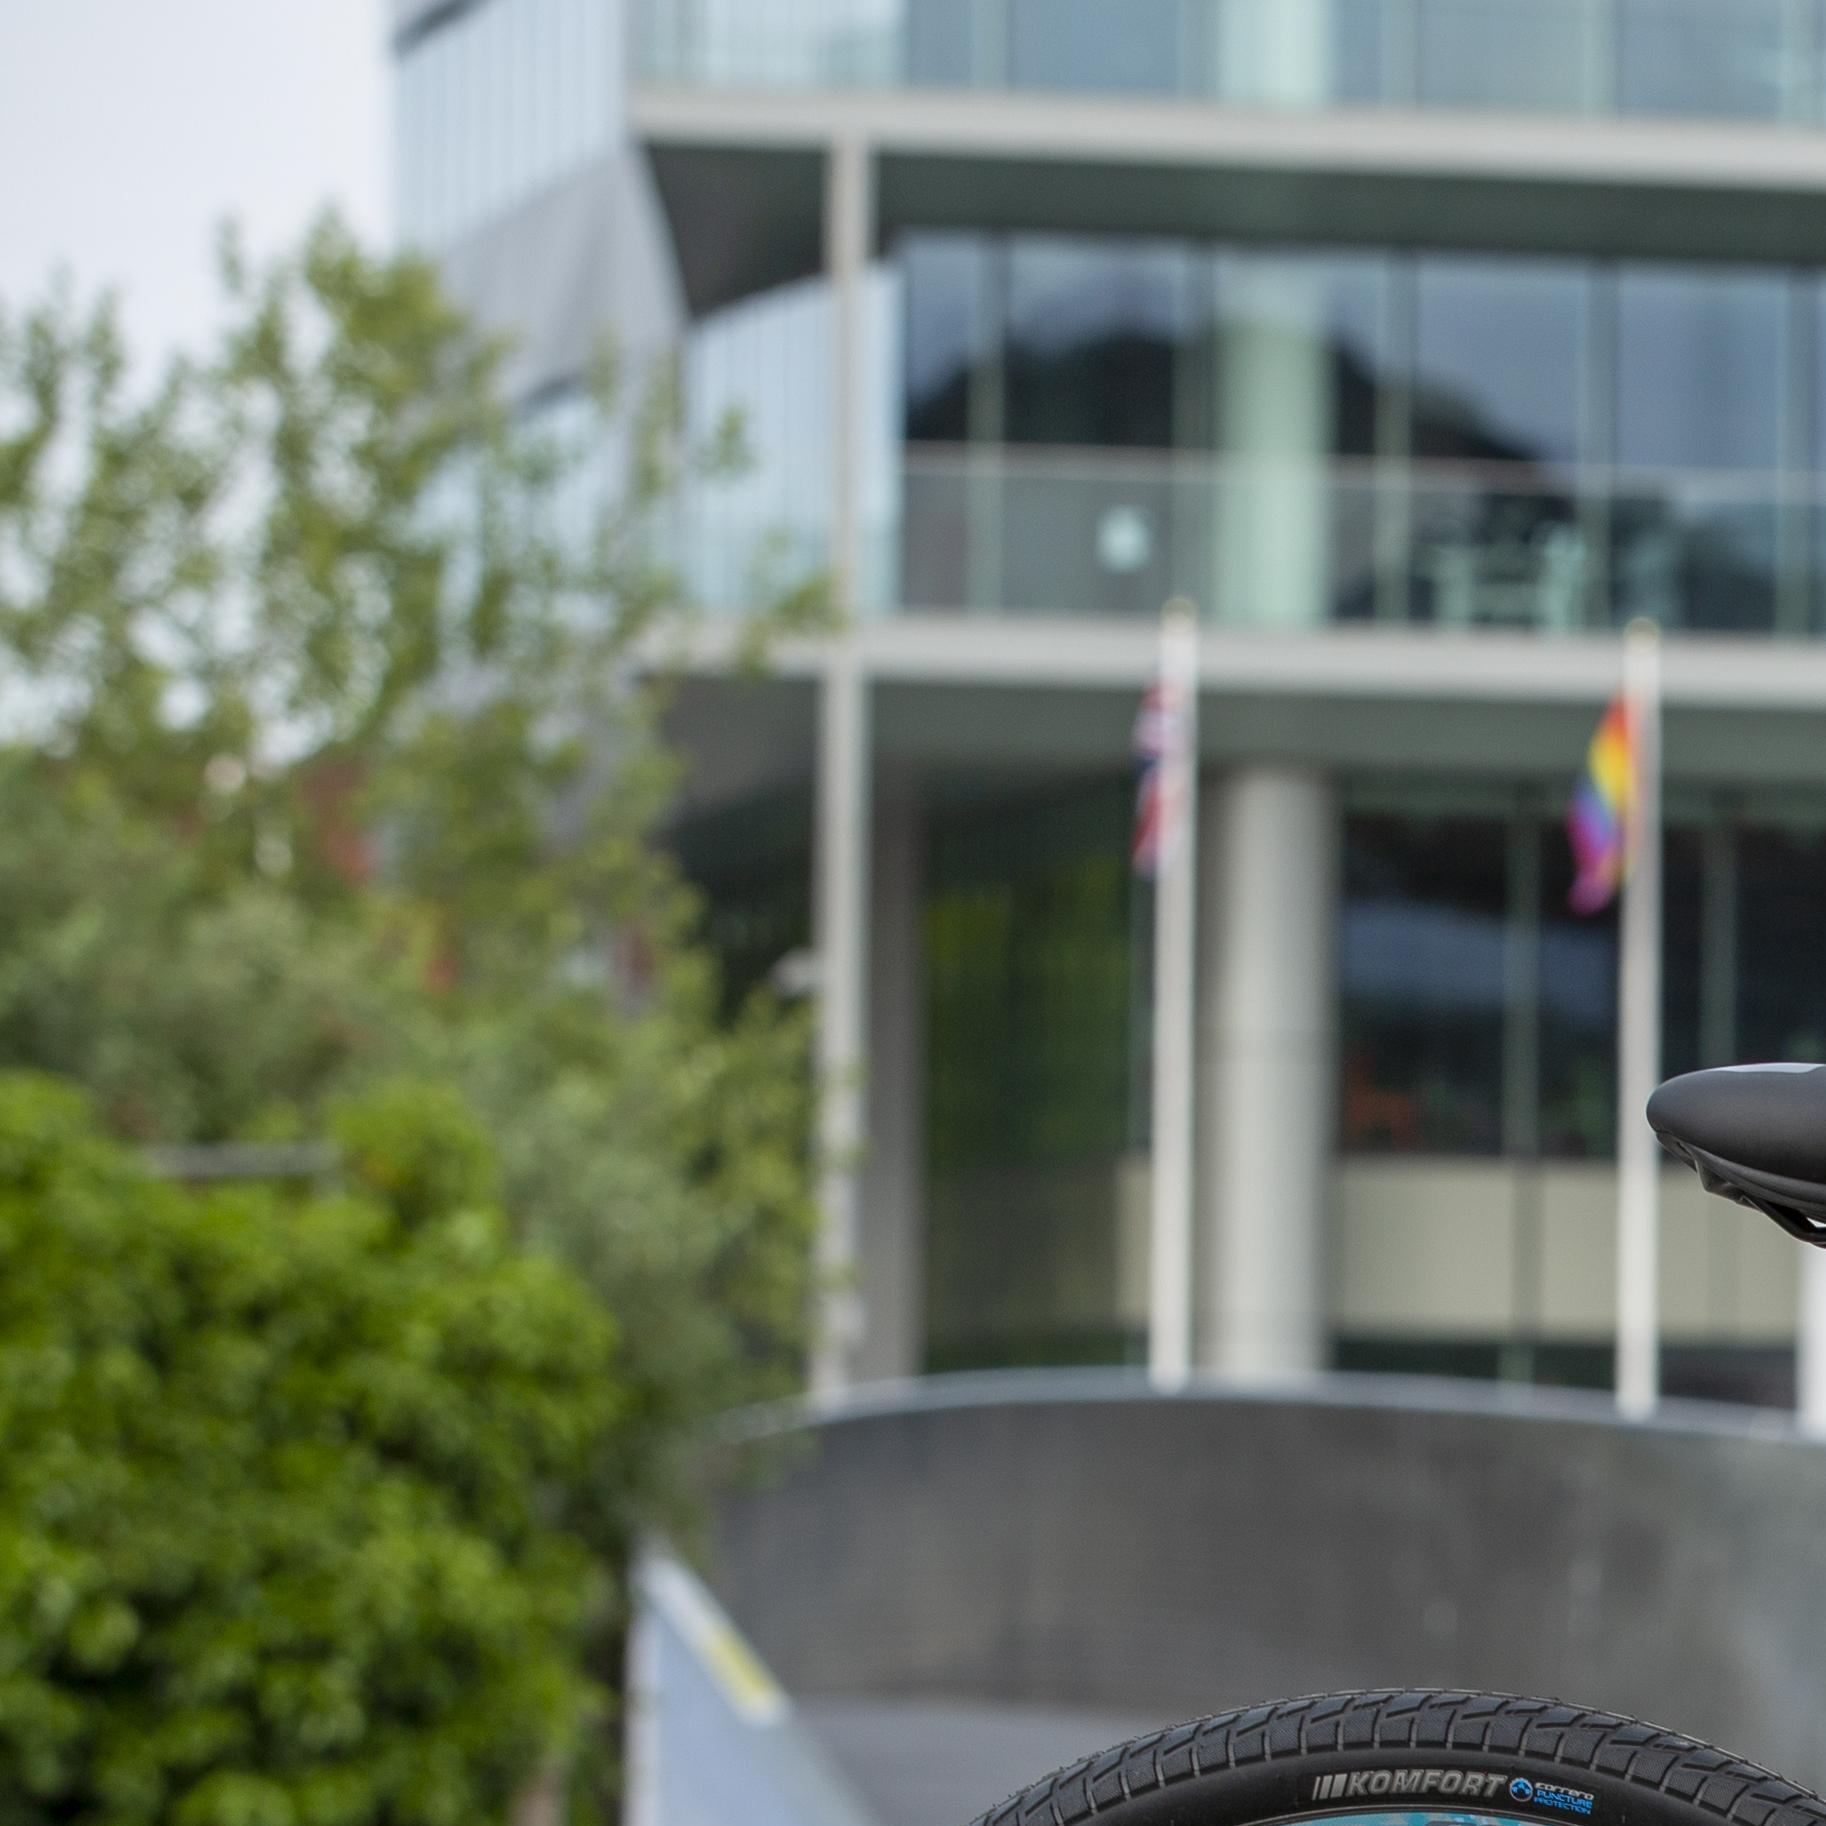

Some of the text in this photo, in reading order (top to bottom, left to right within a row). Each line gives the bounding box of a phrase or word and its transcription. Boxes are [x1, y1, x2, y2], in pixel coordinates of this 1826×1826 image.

[1345, 1769, 1508, 1798] KOMFORT
[1534, 1782, 1595, 1800] carrera
[1533, 1797, 1592, 1815] PROTECTION
[1536, 1789, 1593, 1809] PUNCTURE
